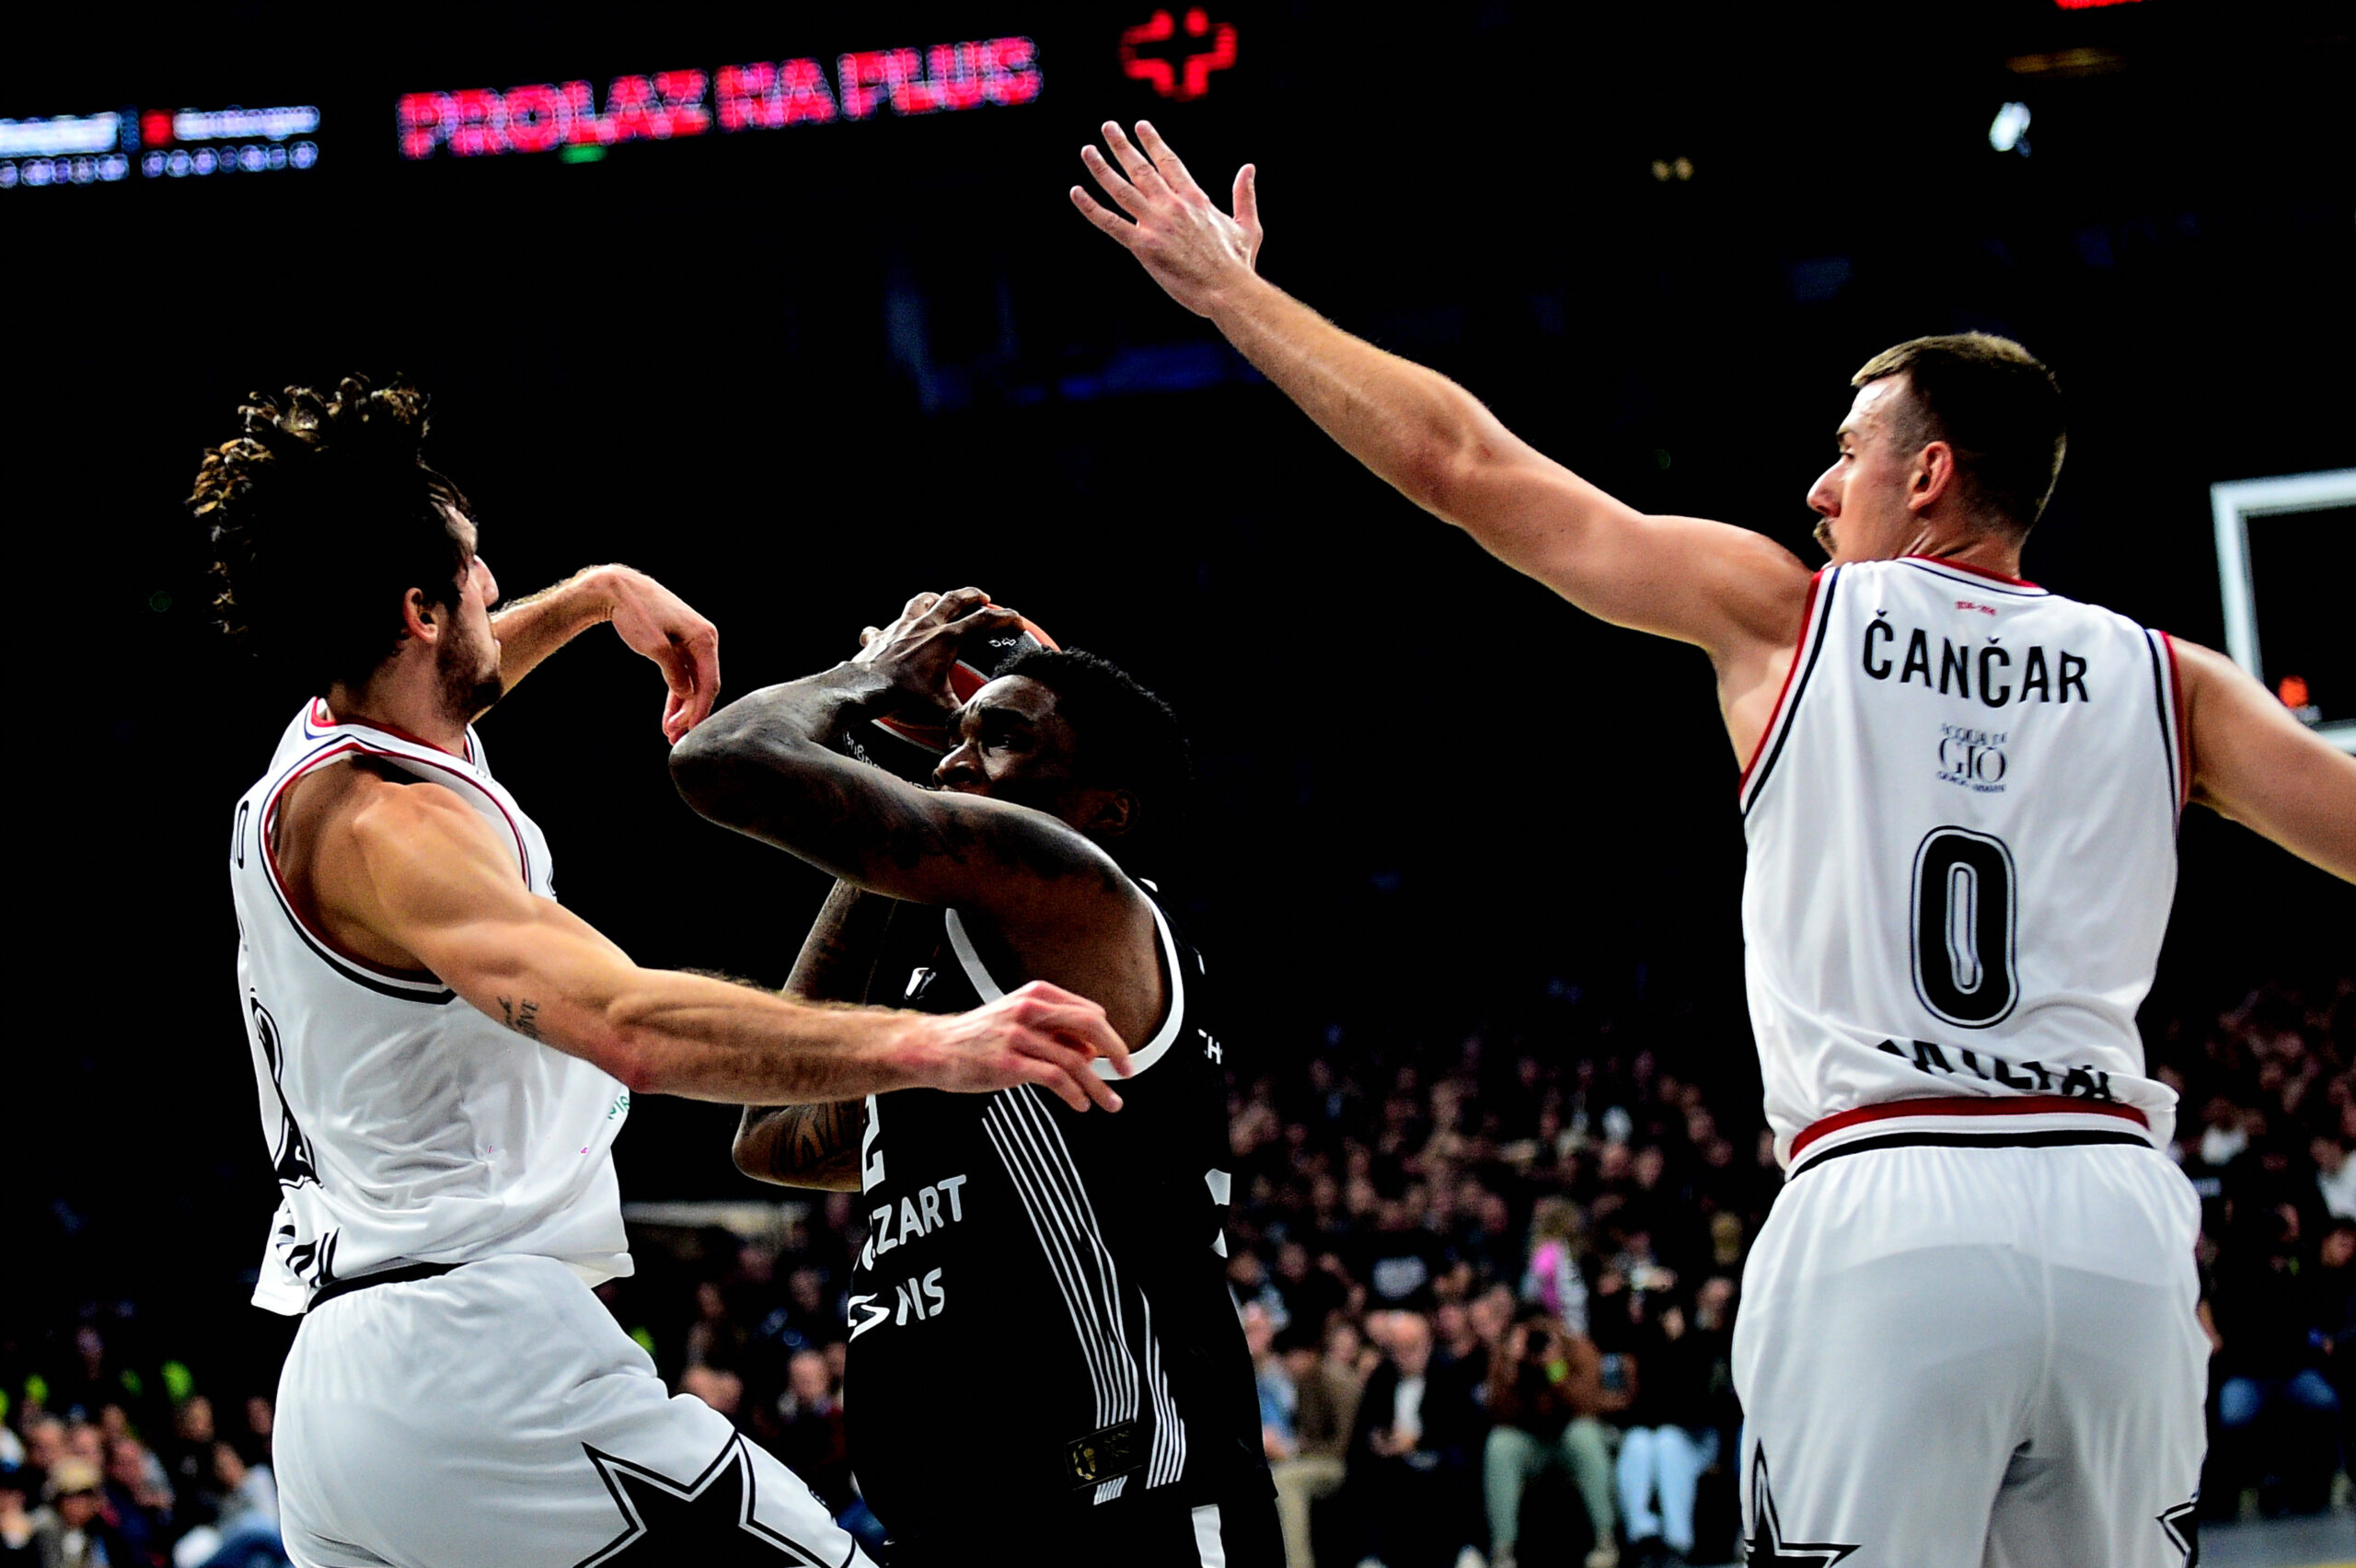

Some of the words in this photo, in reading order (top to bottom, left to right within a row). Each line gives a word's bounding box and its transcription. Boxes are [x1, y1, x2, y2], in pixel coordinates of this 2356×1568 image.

[398, 68, 710, 162] PROLAZ
[715, 58, 840, 132] NA
[838, 36, 1044, 121] PLUS
[1863, 608, 2090, 708] ČANČAR
[1910, 824, 2019, 1030] 0
[861, 1173, 967, 1272] ZART
